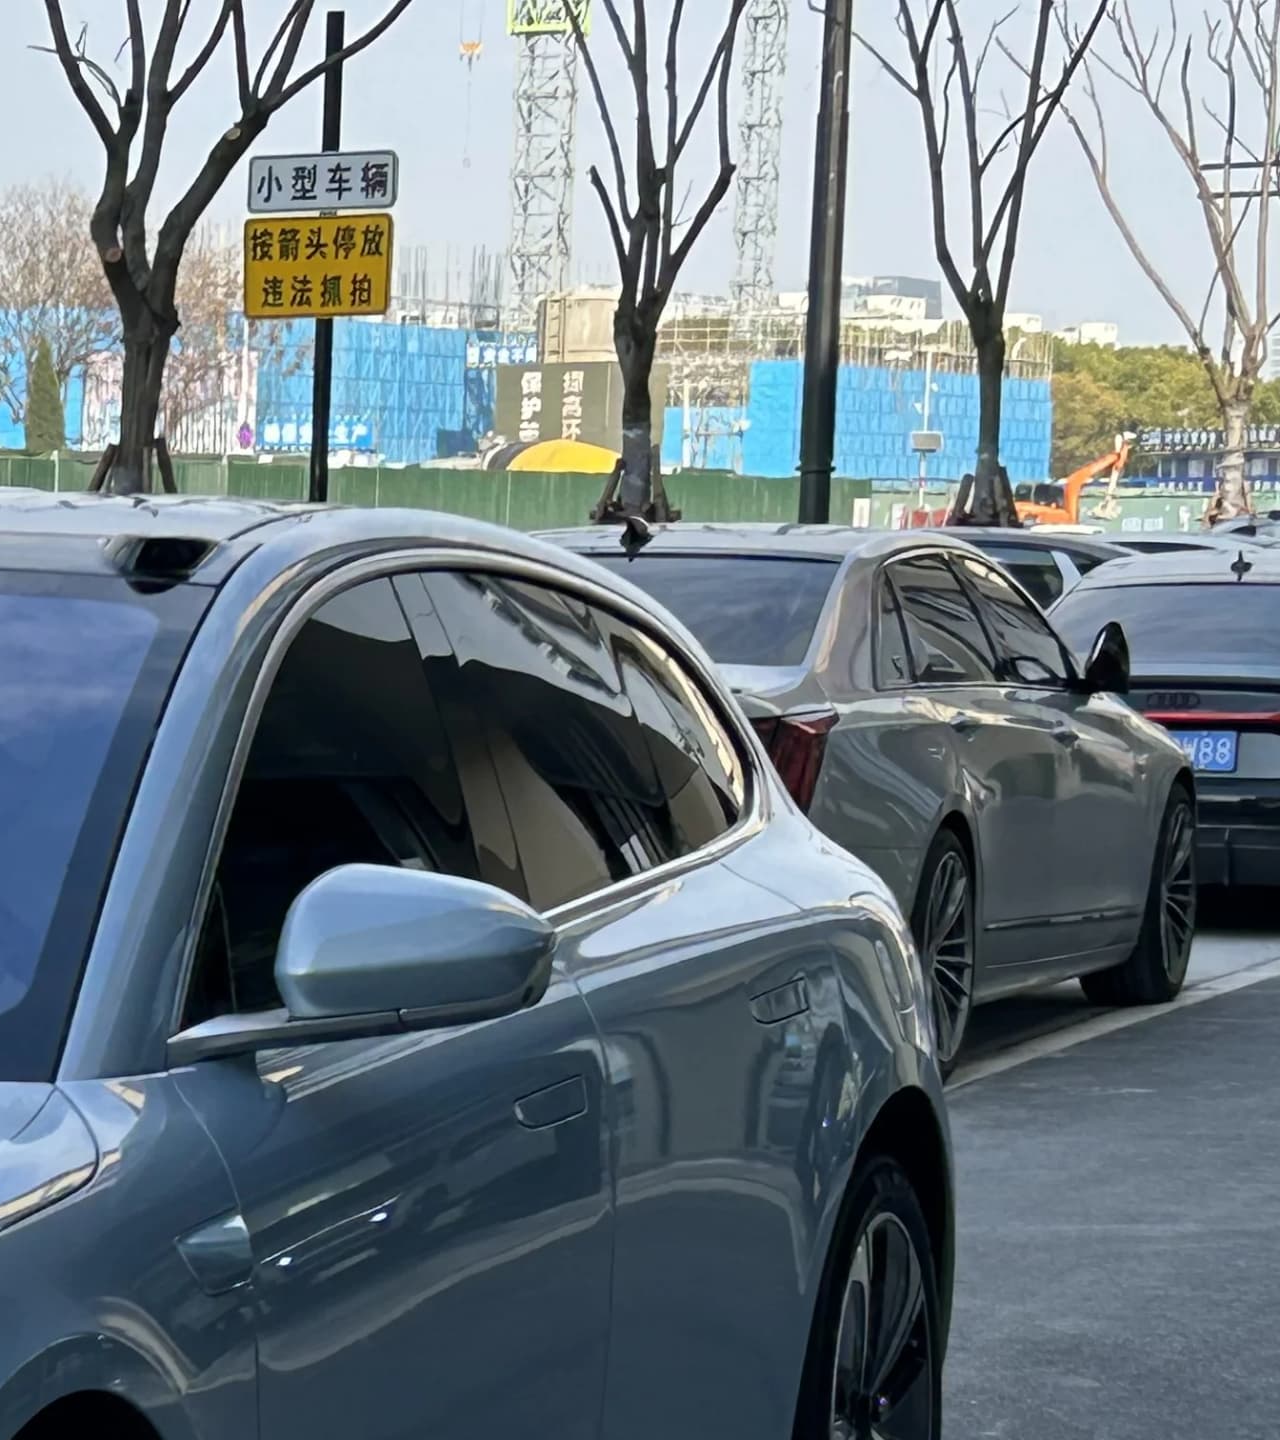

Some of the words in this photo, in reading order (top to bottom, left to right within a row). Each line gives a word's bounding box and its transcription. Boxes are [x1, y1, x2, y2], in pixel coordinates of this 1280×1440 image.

[257, 162, 389, 203] 小型车辆
[251, 223, 385, 262] 按箭头停放
[262, 272, 372, 308] 违法抓拍
